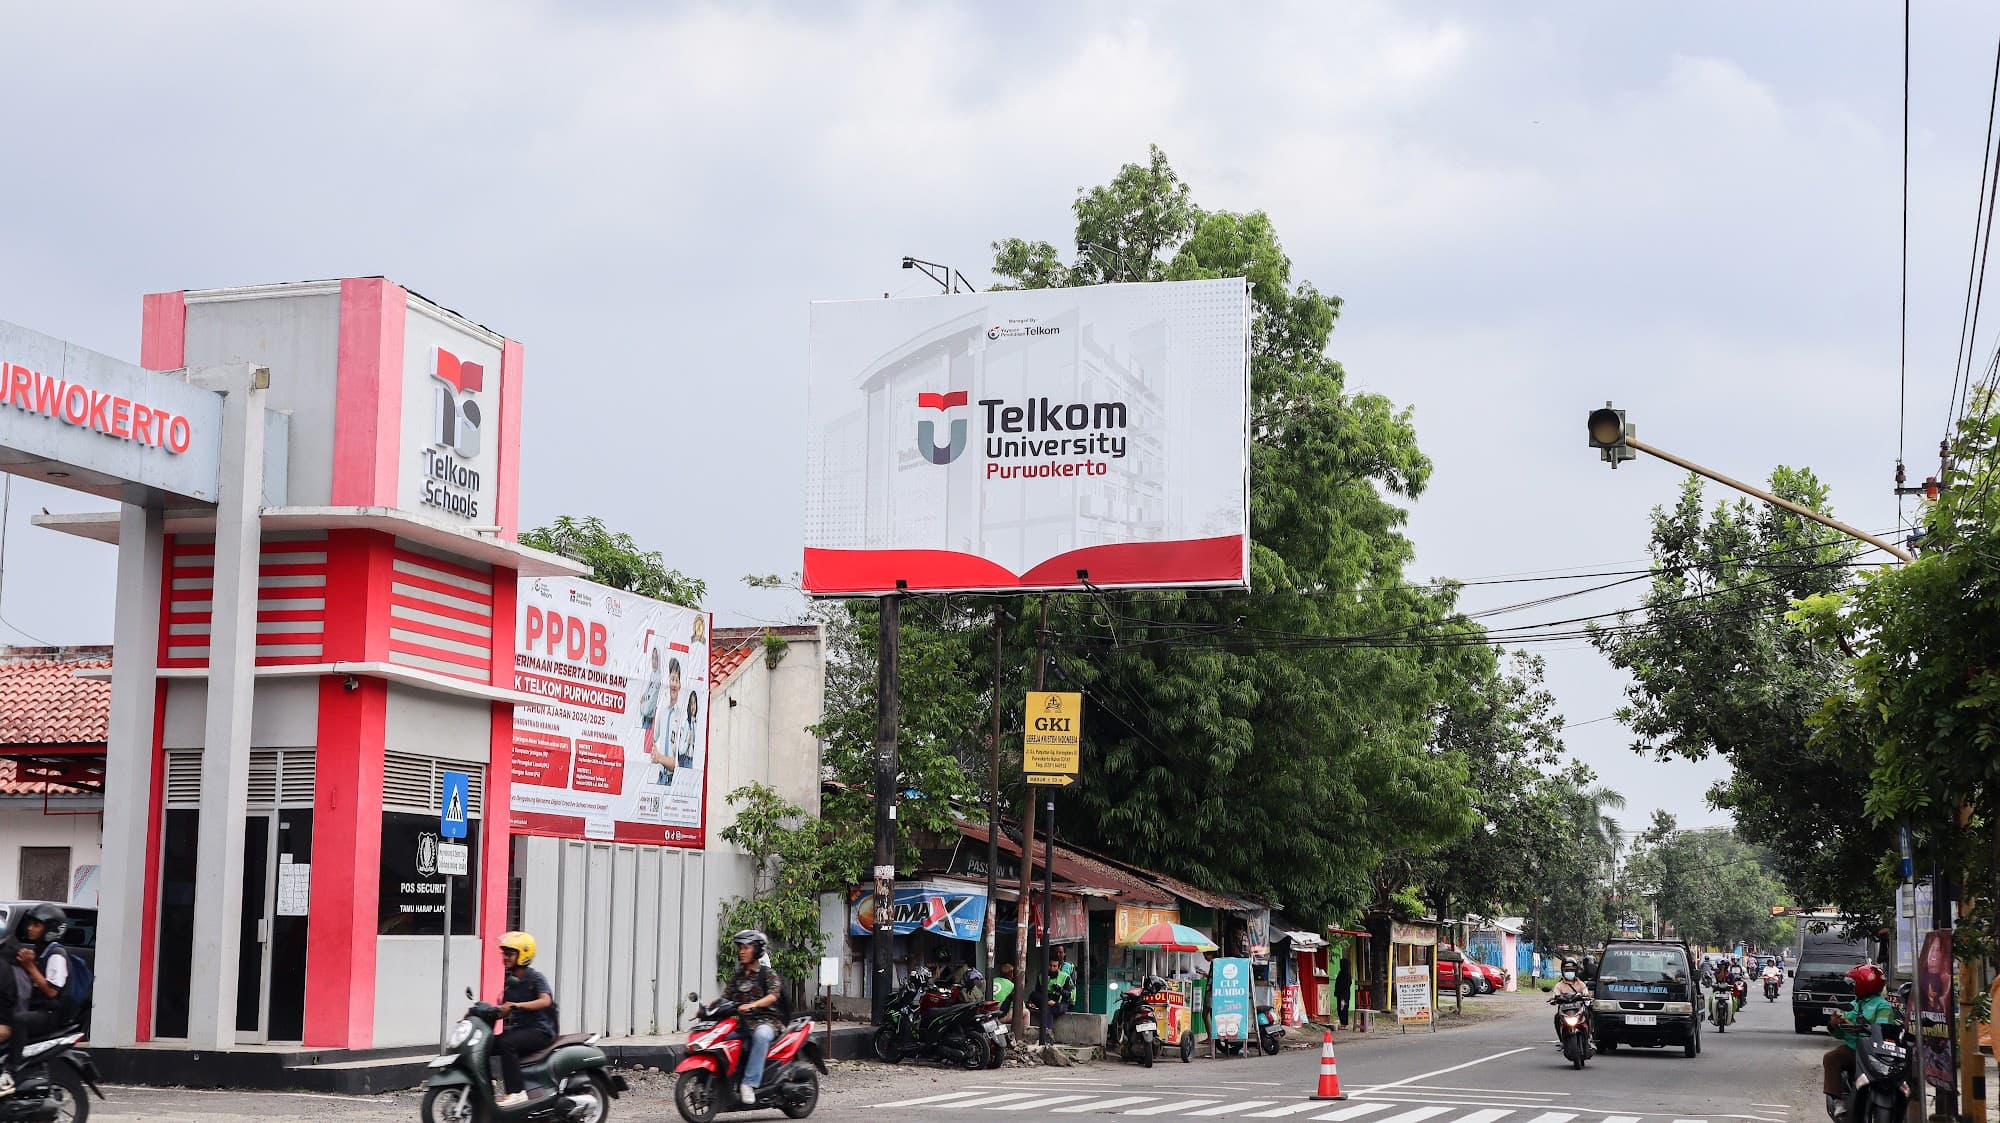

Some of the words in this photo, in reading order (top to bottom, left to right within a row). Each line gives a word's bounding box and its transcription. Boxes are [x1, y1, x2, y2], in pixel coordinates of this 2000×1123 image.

[1025, 326, 1060, 336] Telkom
[0, 362, 190, 454] RWOKERTO
[978, 397, 1127, 434] Telkom
[986, 432, 1126, 459] University
[426, 448, 480, 492] Telkom
[987, 459, 1107, 480] Purwokerto
[425, 480, 478, 518] Schools
[526, 605, 607, 667] PPDB
[553, 662, 587, 677] PESERTA
[587, 669, 608, 684] DIDIK
[609, 675, 628, 689] BARU
[514, 675, 522, 690] K
[524, 676, 562, 698] TELKOM
[564, 685, 624, 710] PURWOKERTO
[572, 711, 606, 726] 2024/2025
[1035, 717, 1070, 731] GKI
[401, 883, 415, 894] POS
[416, 883, 447, 894] SECURIT
[400, 904, 414, 913] TAMU
[415, 904, 433, 913] HARAP
[1213, 987, 1245, 997] JUMBO
[1220, 980, 1239, 988] CUP
